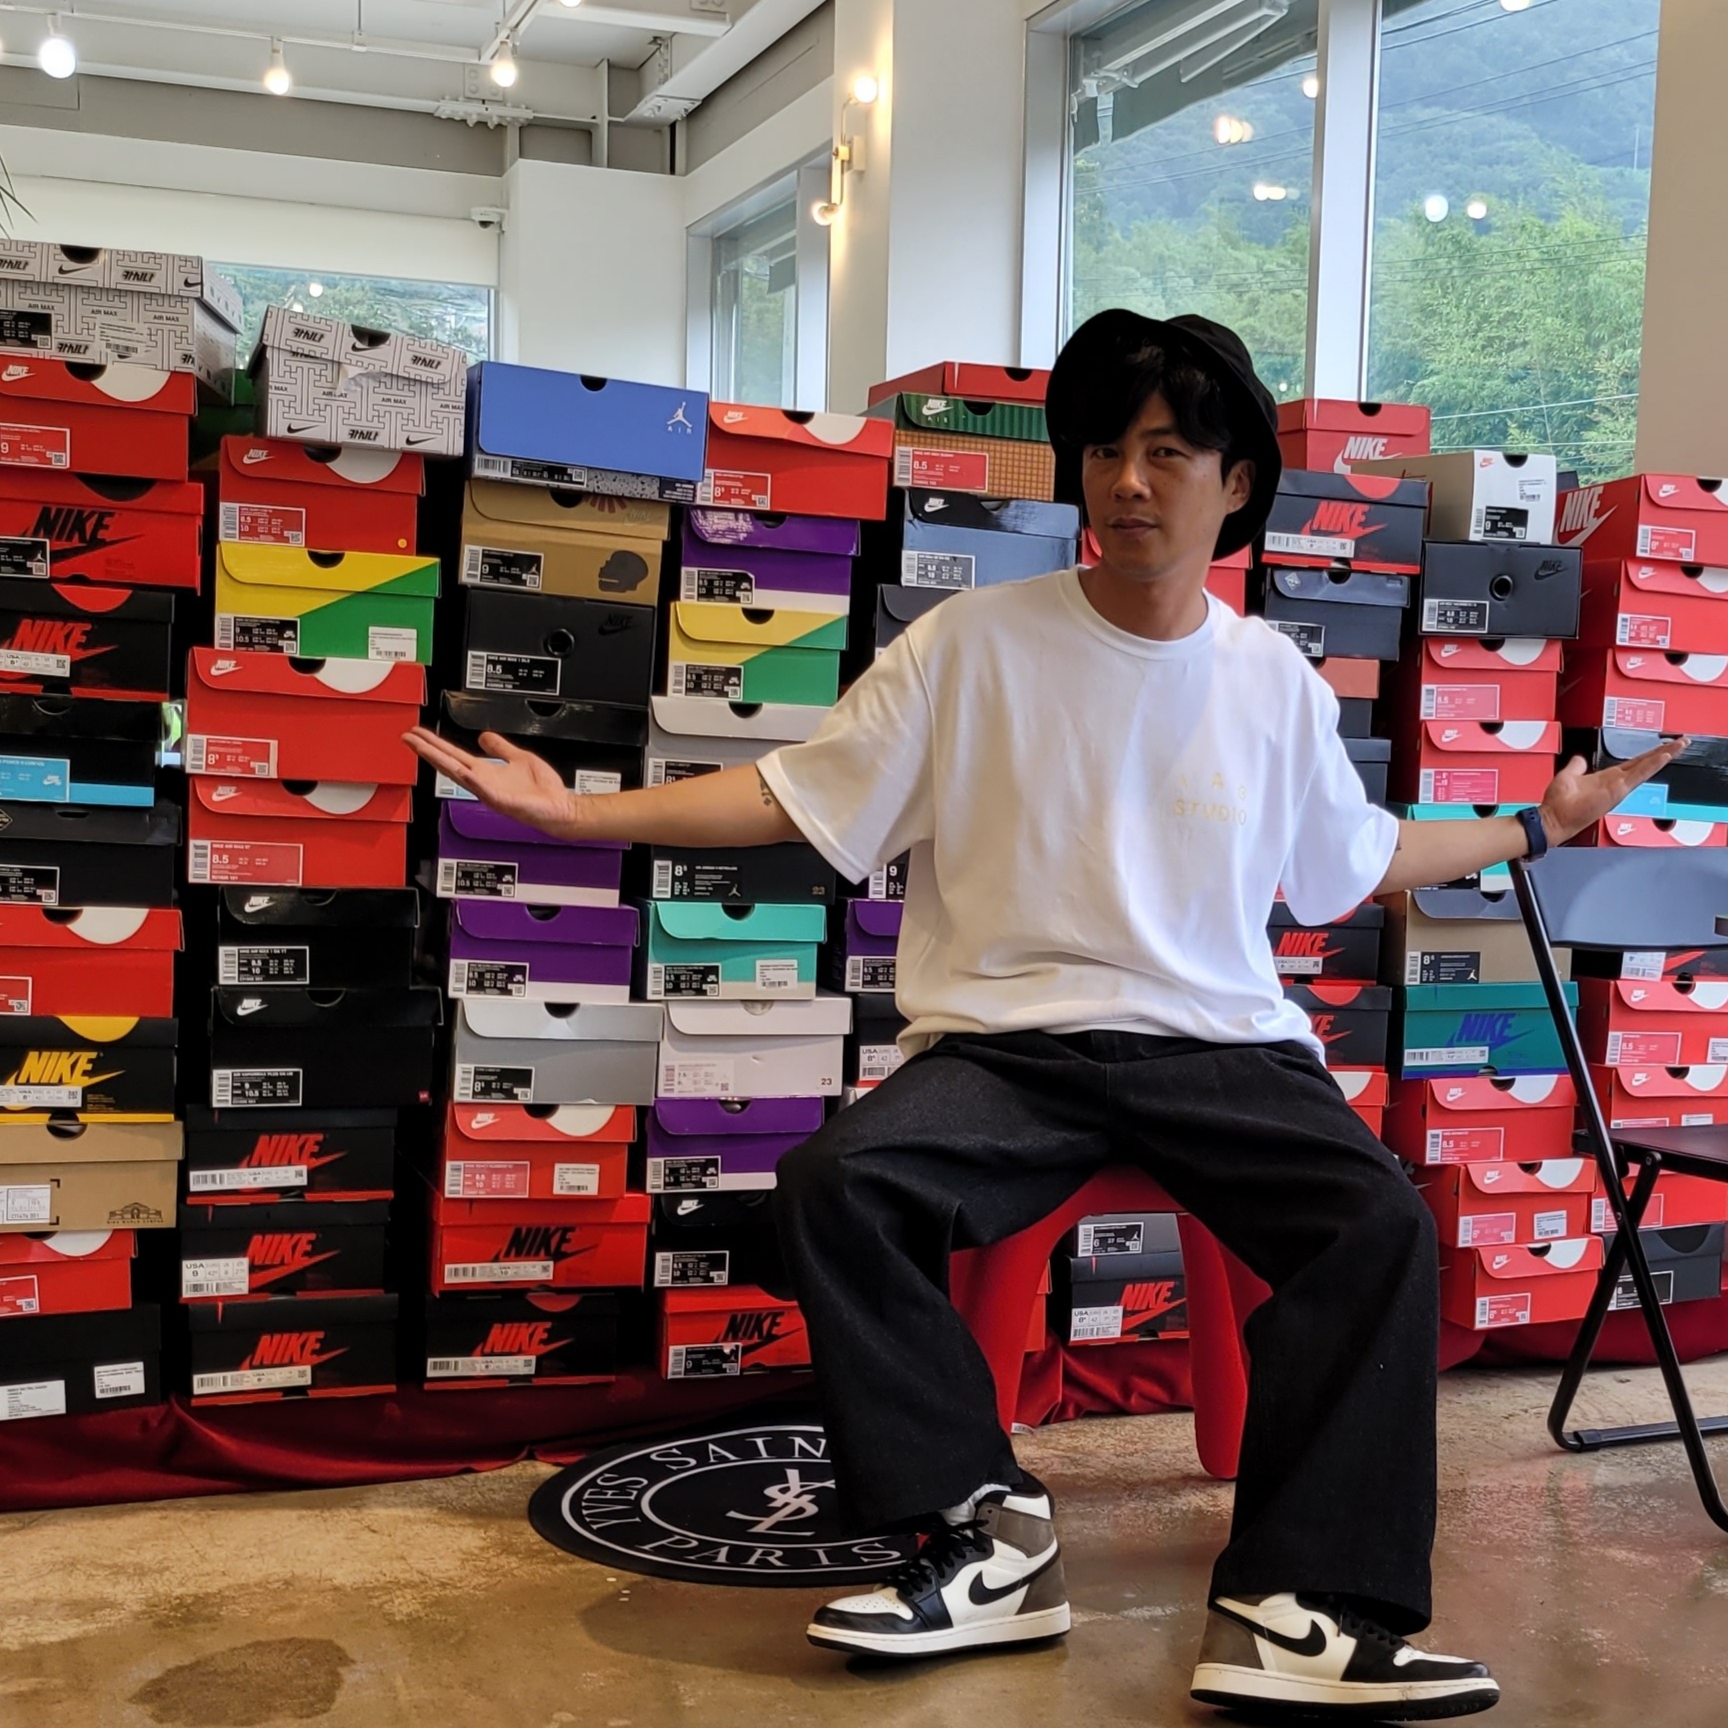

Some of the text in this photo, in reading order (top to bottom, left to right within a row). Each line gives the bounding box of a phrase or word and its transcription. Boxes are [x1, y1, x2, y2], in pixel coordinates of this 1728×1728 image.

[668, 426, 692, 434] AIR
[1344, 436, 1388, 460] NIKE
[31, 505, 116, 543] NIKE
[1312, 501, 1370, 532] NIKE
[1560, 485, 1604, 534] NIKE
[1540, 560, 1563, 570] NIKE
[11, 618, 92, 652] NIKE
[606, 614, 633, 627] NIKE
[1174, 798, 1247, 826] STUDIO
[889, 865, 898, 876] 9
[1276, 932, 1329, 956] NIKE
[1456, 1013, 1517, 1042] NIKE
[17, 1051, 98, 1084] NIKE
[820, 1078, 832, 1086] 23
[251, 1132, 324, 1166] NIKE
[246, 1232, 316, 1266] NIKE
[502, 1226, 576, 1258] NIKE
[1120, 1282, 1174, 1310] NIKE
[482, 1322, 552, 1354] NIKE
[722, 1312, 785, 1342] NIKE
[252, 1331, 325, 1366] NIKE
[581, 1436, 827, 1530] YVES SAIN
[635, 1535, 901, 1566] PARIS
